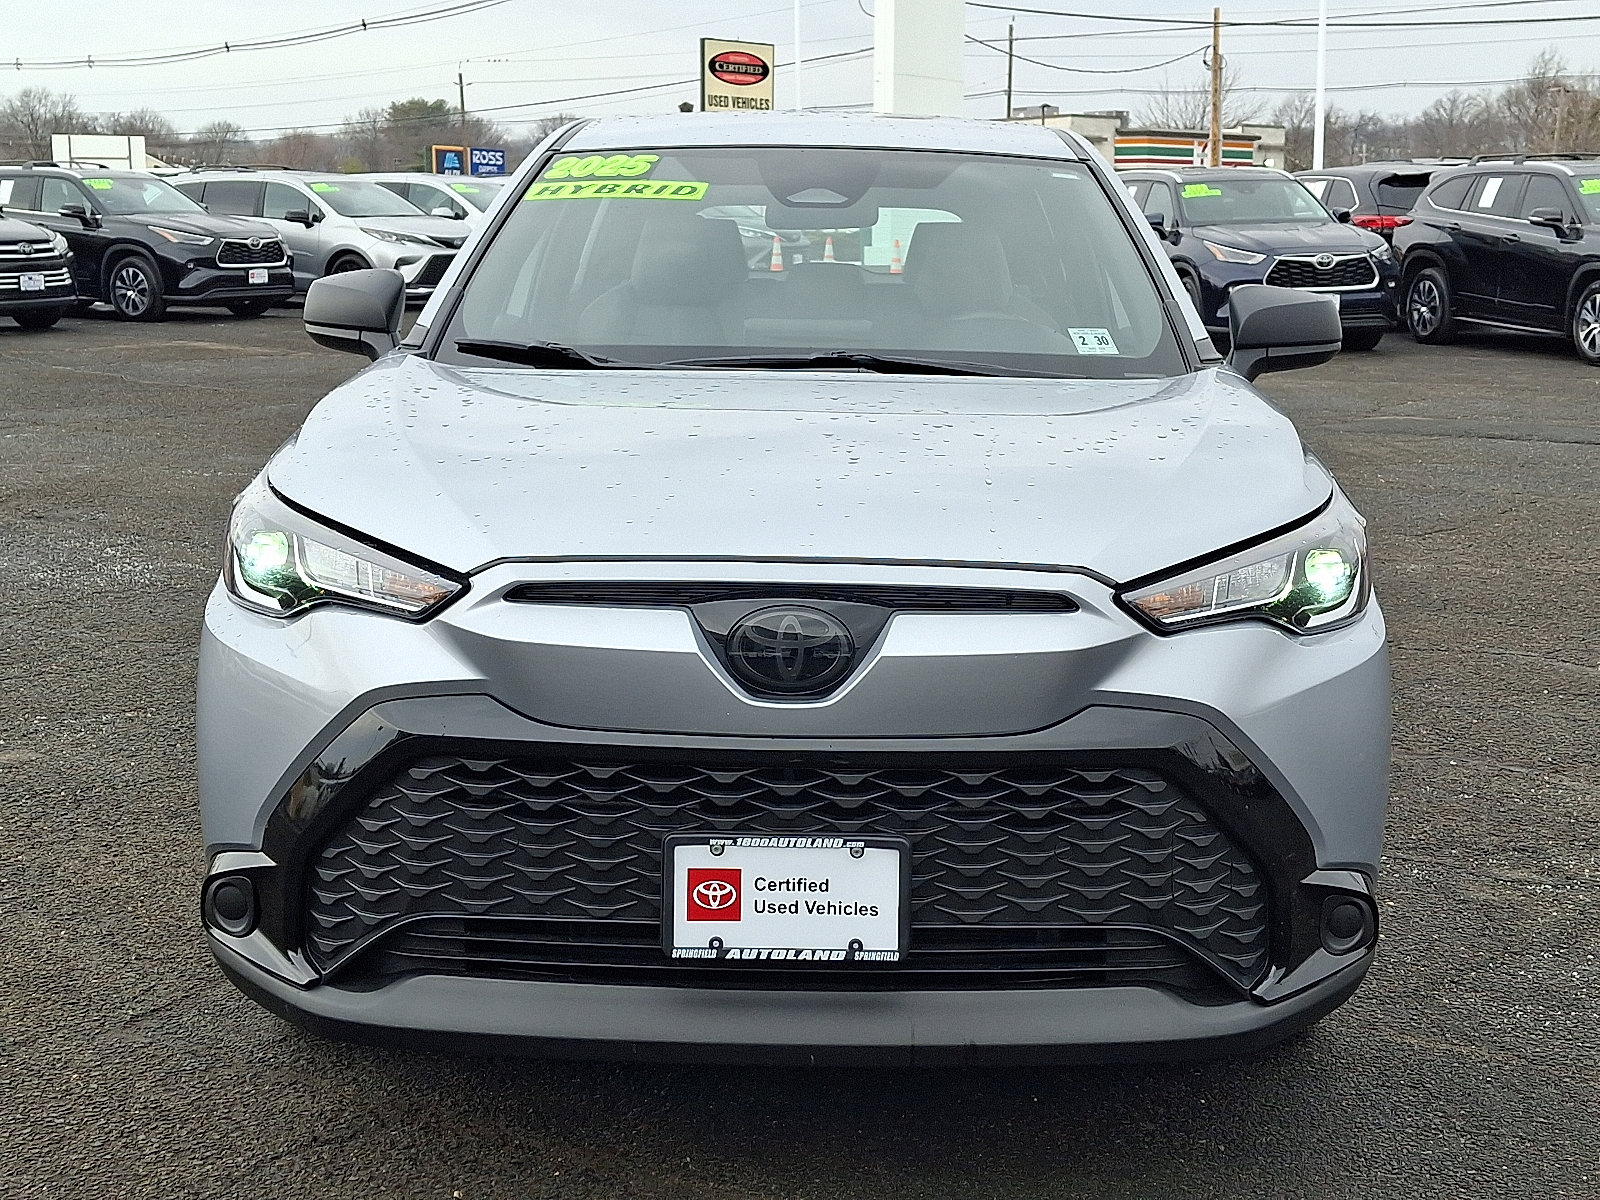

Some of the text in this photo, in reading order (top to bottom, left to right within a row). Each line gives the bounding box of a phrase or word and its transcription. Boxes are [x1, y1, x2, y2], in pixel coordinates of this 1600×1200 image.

[715, 61, 763, 74] CERTIFIED
[708, 94, 770, 111] USED VEHICLES
[472, 150, 504, 165] ROSS
[544, 155, 660, 179] 2025
[535, 183, 699, 196] HYBRID
[1078, 335, 1110, 346] 2 30
[709, 837, 865, 849] www.1800AUTOLAND.com
[754, 876, 830, 893] Certified
[753, 899, 880, 917] Used Vehicles
[724, 948, 847, 961] AUTOLAND
